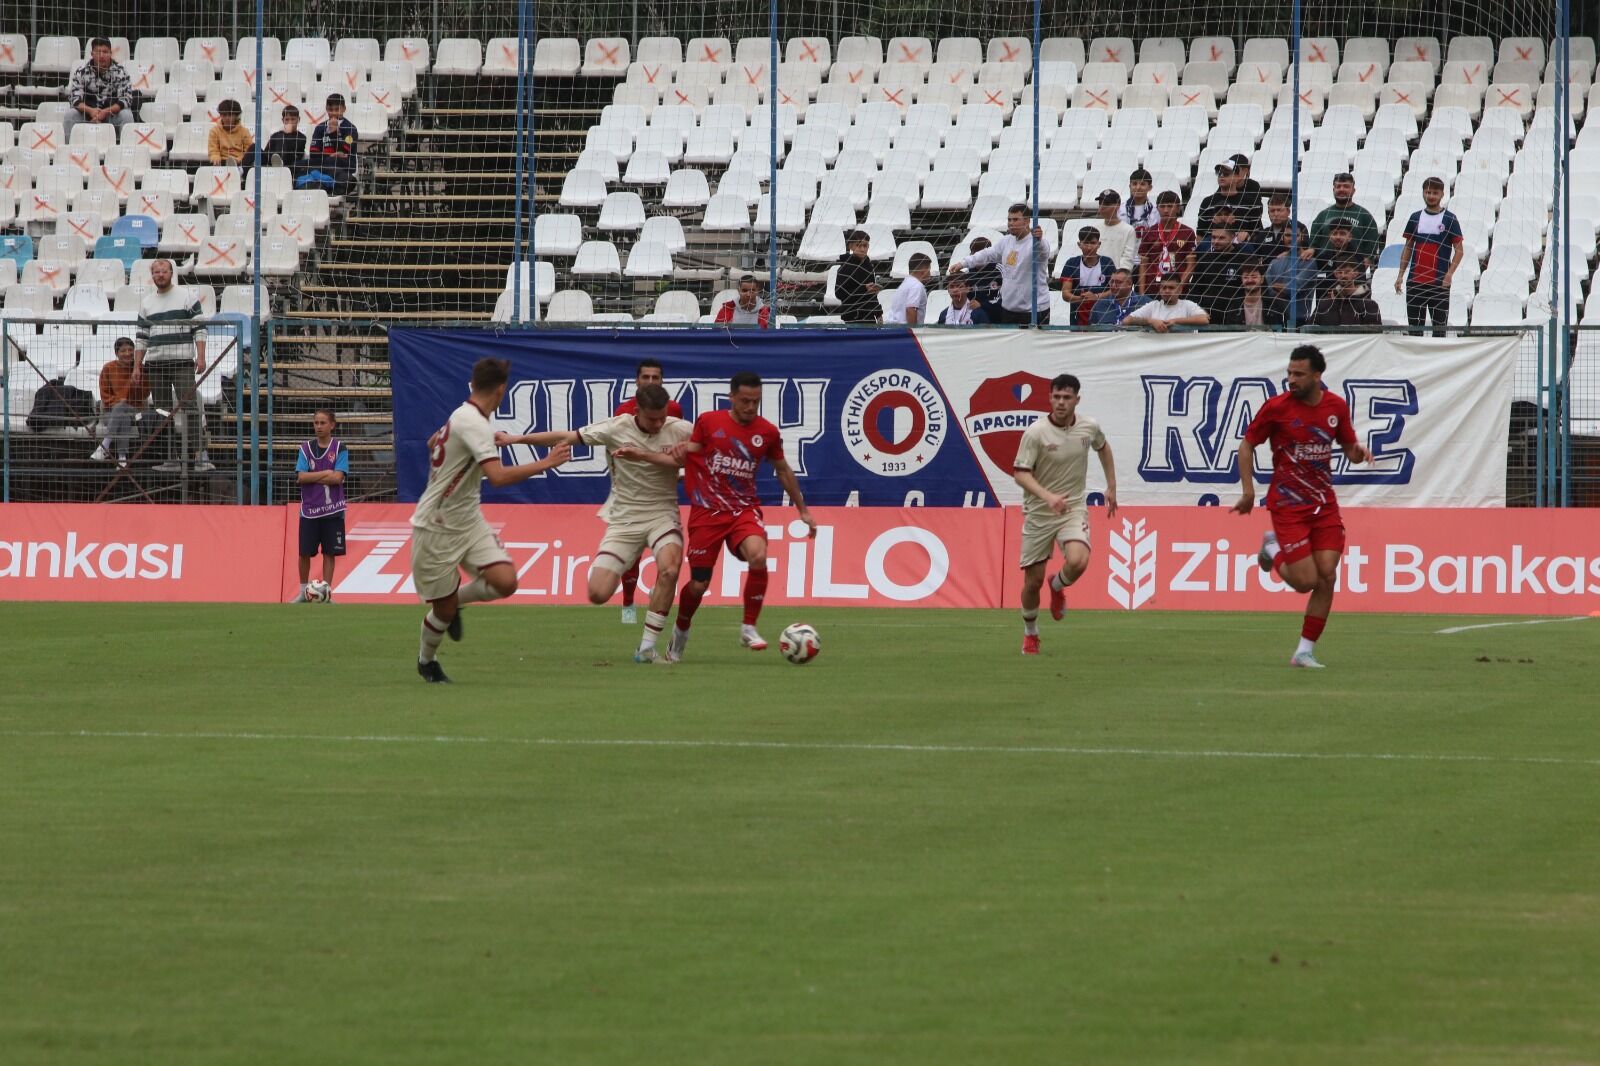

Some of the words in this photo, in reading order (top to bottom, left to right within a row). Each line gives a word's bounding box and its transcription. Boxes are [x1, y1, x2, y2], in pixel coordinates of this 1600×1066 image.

[468, 379, 829, 480] KUY
[913, 382, 944, 446] KULÜBÜ
[1138, 374, 1420, 485] KAE
[882, 462, 906, 472] 1933
[1169, 538, 1369, 593] Zirt
